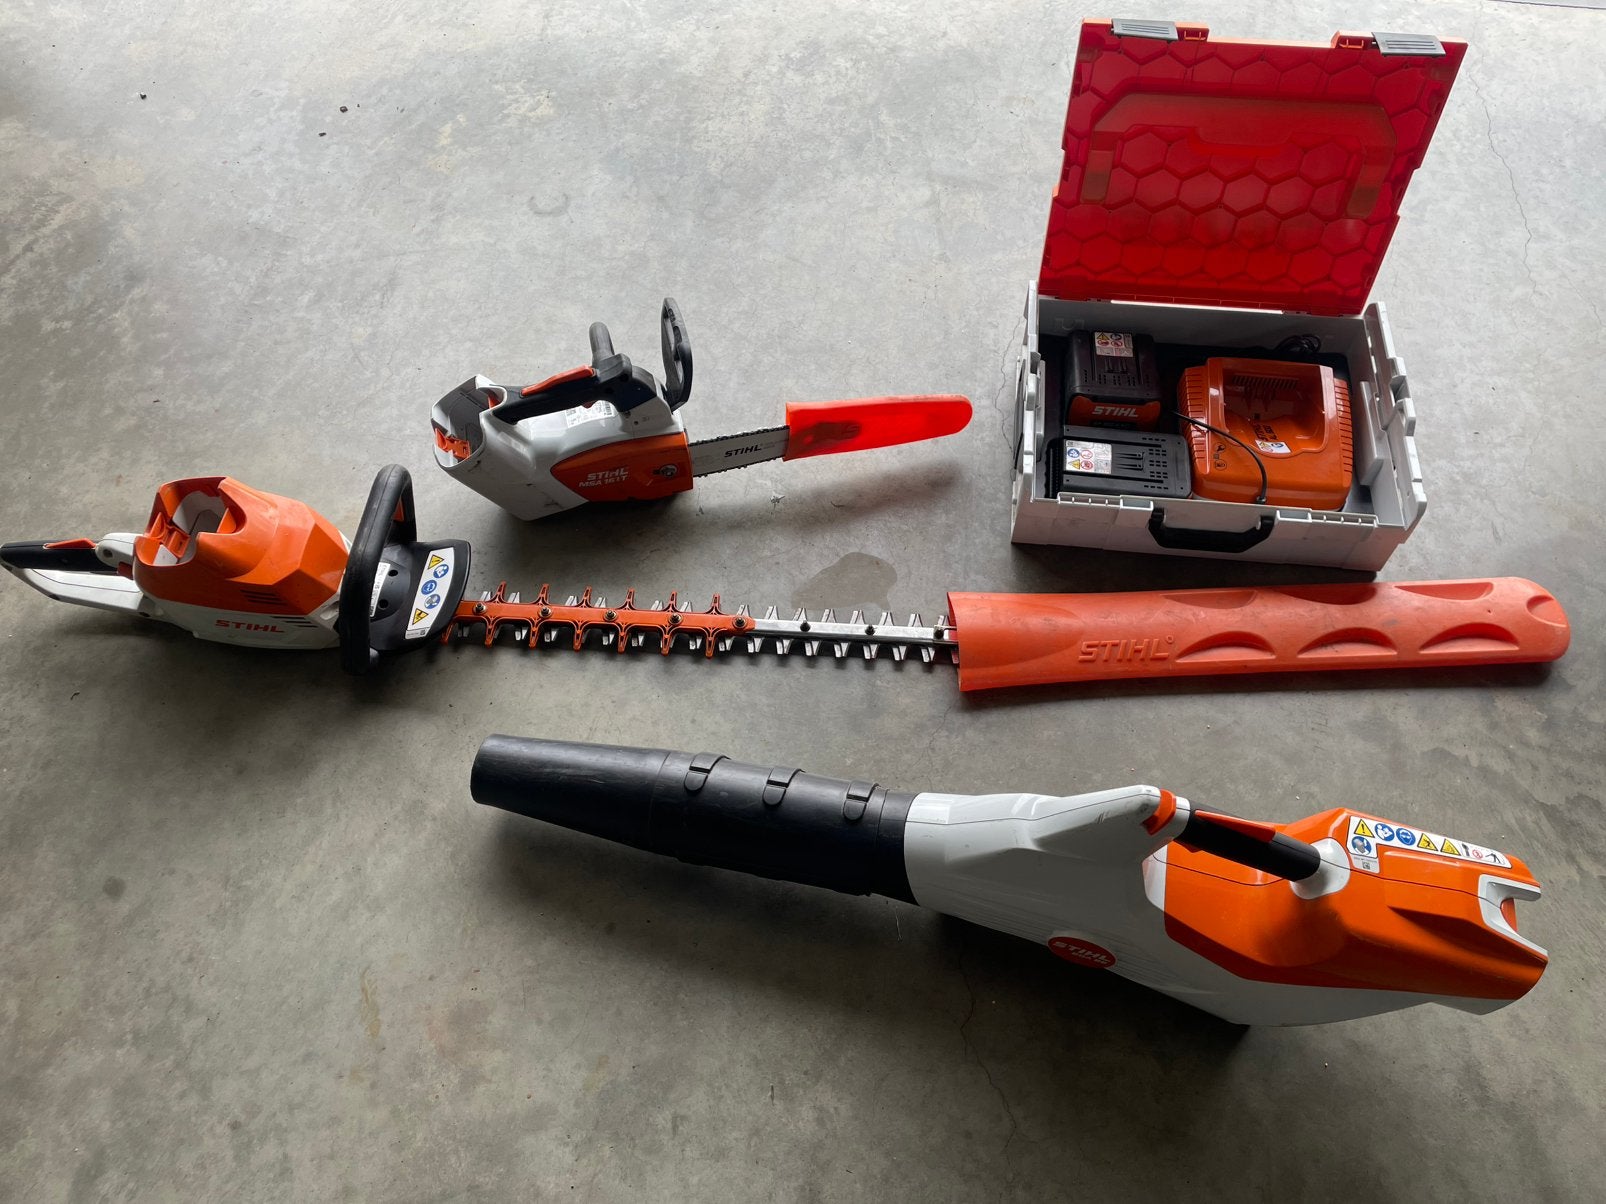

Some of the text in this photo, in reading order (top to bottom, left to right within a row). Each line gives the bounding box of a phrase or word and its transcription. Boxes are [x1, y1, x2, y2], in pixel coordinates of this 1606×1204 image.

[1092, 406, 1139, 418] STIHL
[724, 444, 762, 458] STIHL
[587, 467, 629, 481] STIHL
[215, 619, 285, 633] STIHL
[1078, 638, 1169, 663] STIHL
[1053, 941, 1111, 962] STIHL
